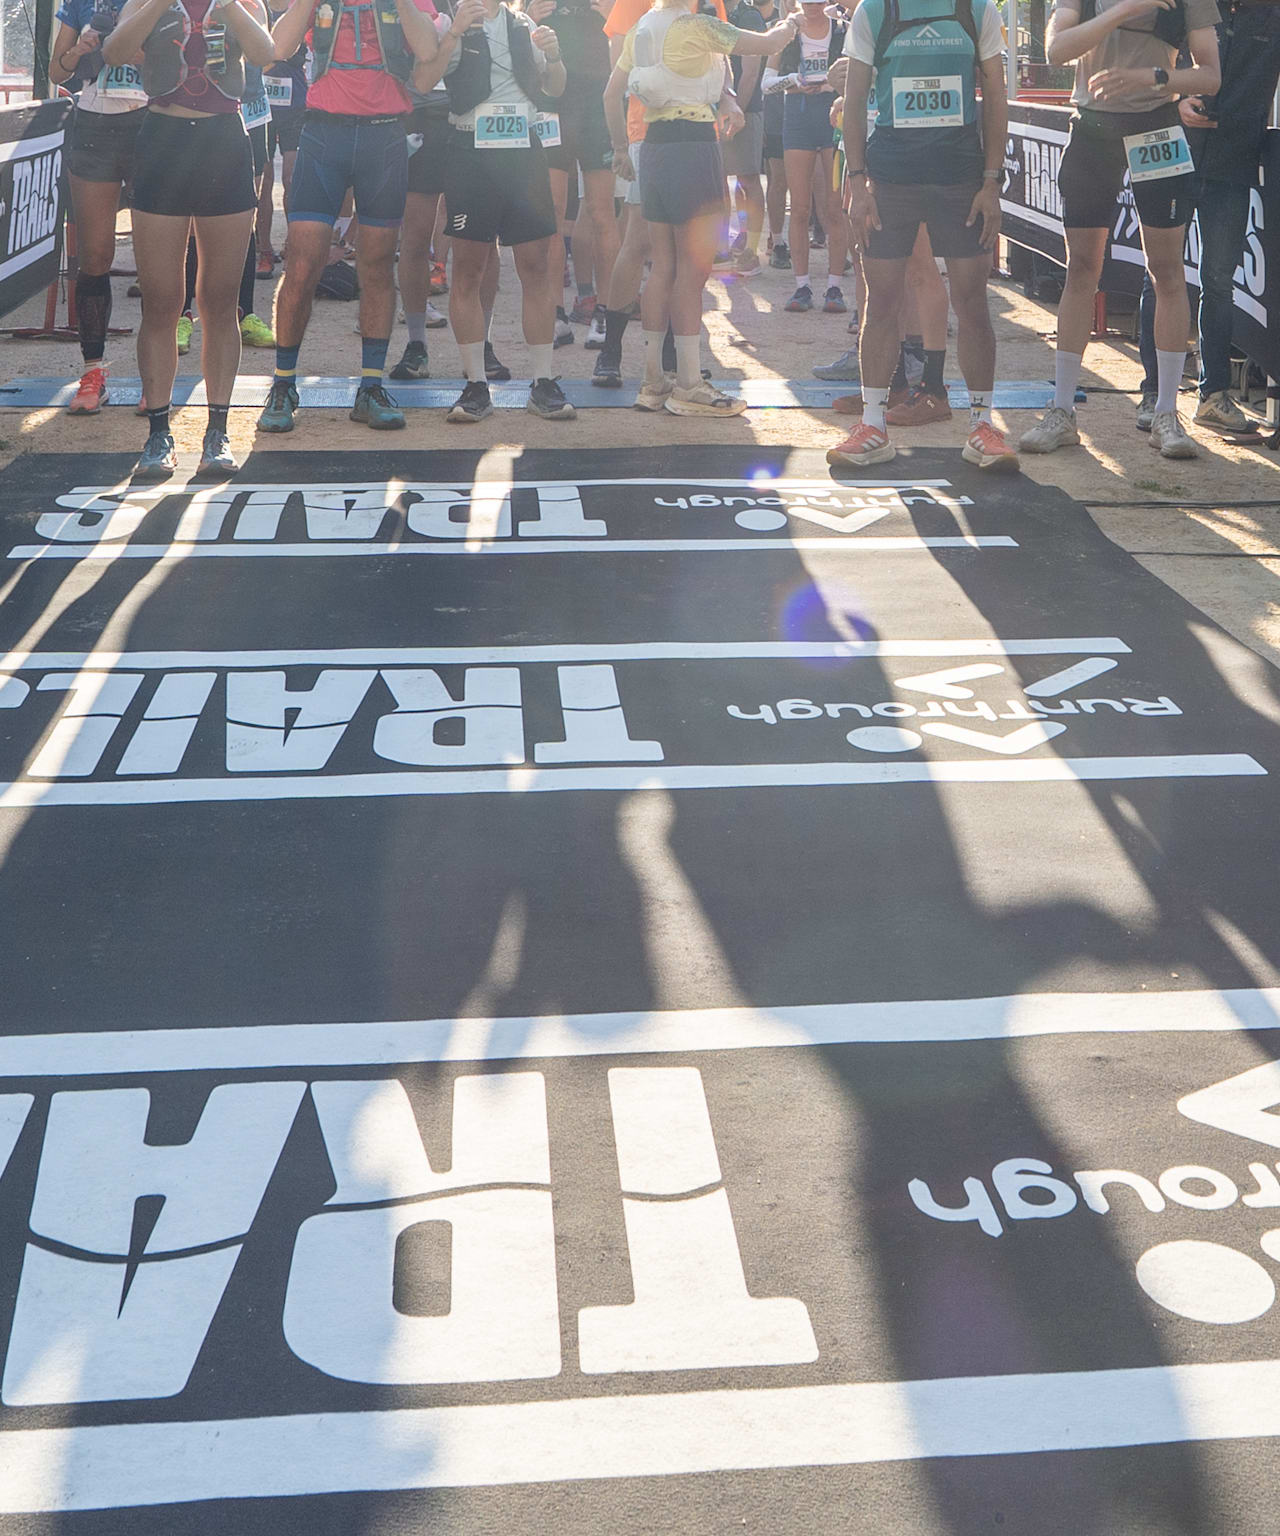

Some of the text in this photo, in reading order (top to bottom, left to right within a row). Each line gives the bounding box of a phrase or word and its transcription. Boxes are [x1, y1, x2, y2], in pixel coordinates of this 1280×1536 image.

[894, 38, 963, 47] FIND YOUR EVEREST
[805, 58, 827, 72] 208
[266, 83, 285, 97] 081
[904, 91, 951, 111] 2030
[485, 117, 523, 133] 2025
[536, 122, 551, 136] 91
[1138, 140, 1180, 165] 2087
[1022, 138, 1064, 219] TRAIL
[7, 149, 63, 256] TRAILS
[35, 485, 608, 542] TRAILS
[726, 694, 1184, 725] RunThrough
